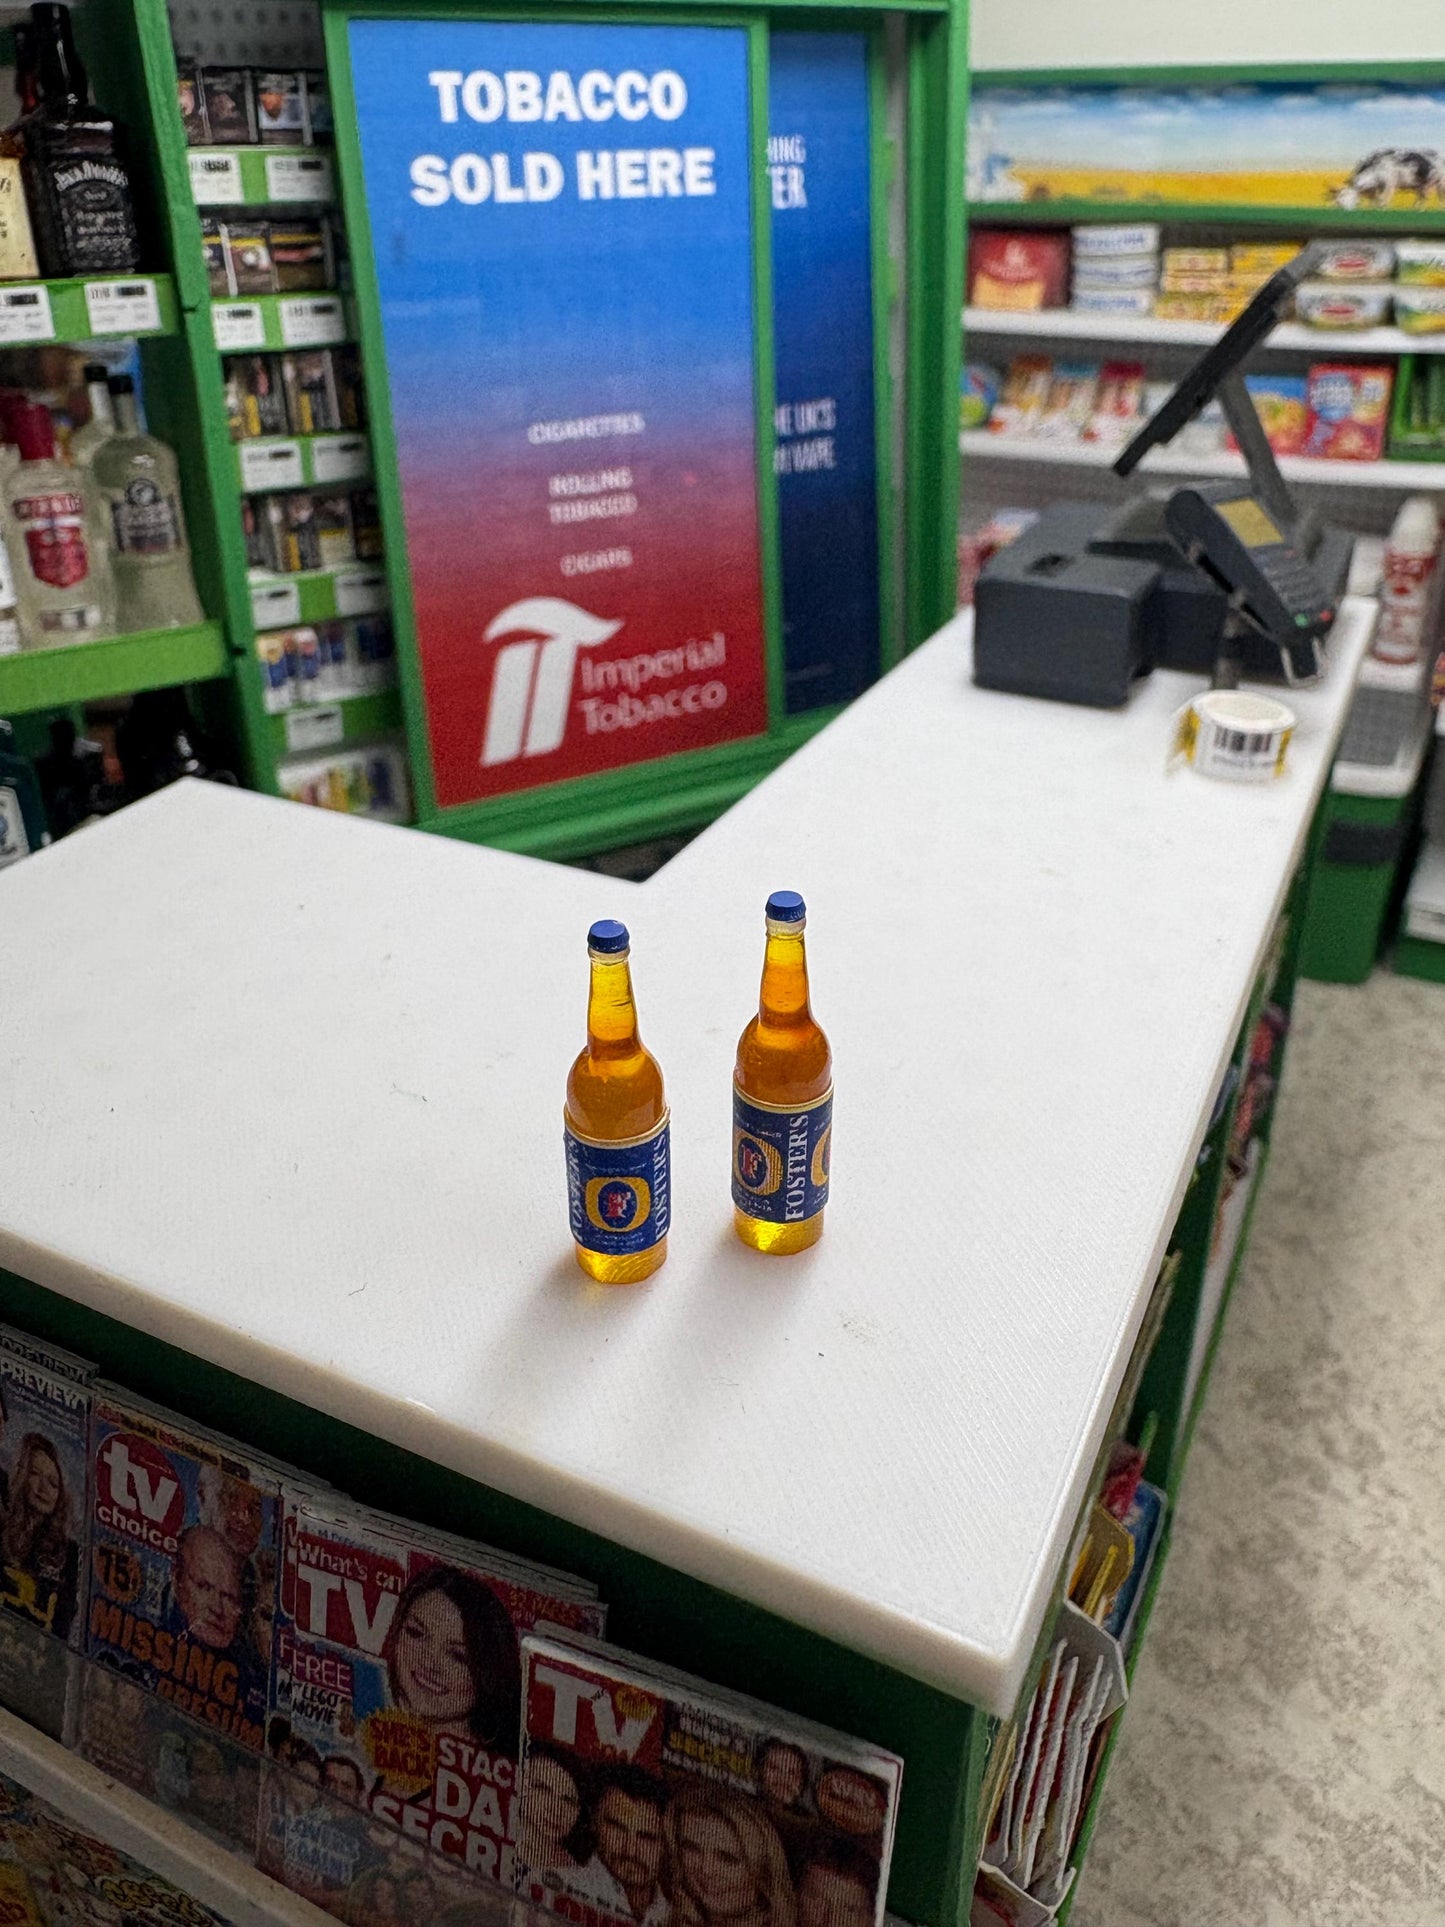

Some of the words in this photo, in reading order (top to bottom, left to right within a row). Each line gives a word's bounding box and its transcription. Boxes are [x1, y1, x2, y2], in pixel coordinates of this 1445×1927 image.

[428, 69, 688, 123] TOBACCO
[410, 152, 564, 206] SOLD
[576, 147, 717, 201] HERE
[581, 631, 726, 693] Imperial
[578, 680, 728, 735] Tobacco
[784, 1115, 809, 1221] FOSTER'S
[1, 1359, 80, 1411] PREVIEW
[103, 1440, 179, 1524] tv
[97, 1504, 180, 1554] choice
[298, 1540, 368, 1582] What's
[297, 1562, 401, 1657] TV
[293, 1650, 351, 1695] FREE
[534, 1663, 658, 1762] TV
